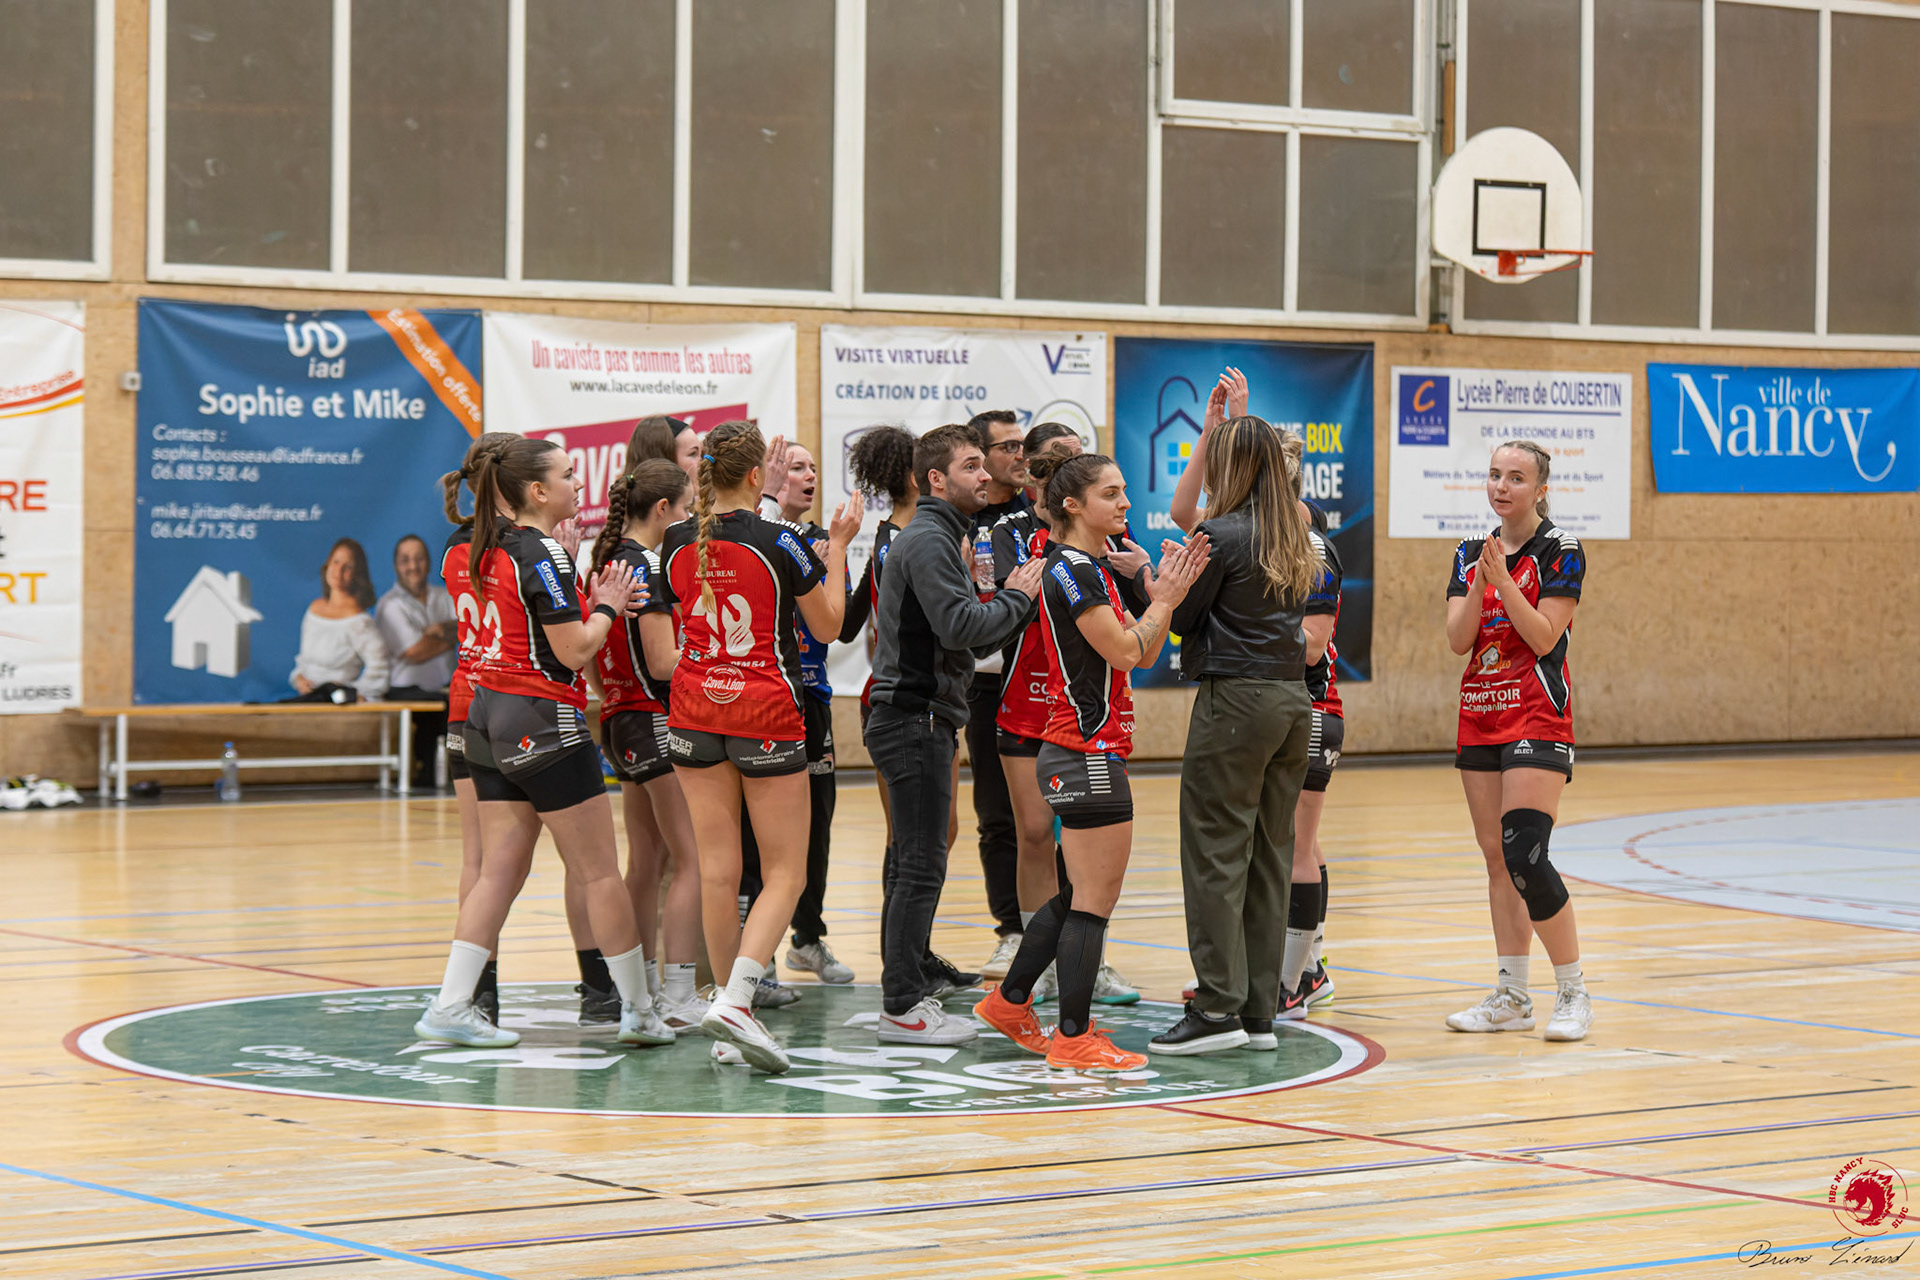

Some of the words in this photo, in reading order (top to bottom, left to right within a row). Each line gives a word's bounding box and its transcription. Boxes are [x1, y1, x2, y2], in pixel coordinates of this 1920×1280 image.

[308, 358, 345, 379] iad
[387, 308, 446, 377] Estimation
[442, 376, 482, 424] offerte
[532, 340, 550, 369] Un
[554, 342, 601, 371] caviste
[606, 350, 628, 375] pas
[632, 350, 681, 373] comme
[684, 345, 705, 374] les
[709, 347, 752, 375] autres
[835, 347, 884, 364] VISITE
[887, 349, 969, 365] VIRTUELLE
[570, 379, 718, 395] www.lacavedeleon.fr
[835, 380, 915, 401] CRÉATION
[920, 385, 939, 400] DE
[945, 385, 987, 401] LOGO
[1457, 377, 1492, 410] Lycée
[1495, 379, 1529, 405] Pierre
[1533, 381, 1547, 405] de
[1550, 382, 1622, 407] COUBERTIN
[1759, 375, 1802, 405] ville
[1807, 376, 1831, 405] de
[198, 384, 304, 424] Sophie
[312, 392, 346, 419] et
[353, 389, 426, 419] Mike
[152, 424, 217, 442] Contacts
[1306, 423, 1343, 453] BOX
[1512, 427, 1557, 439] SECONDE
[1577, 429, 1595, 440] BTS
[1671, 372, 1897, 483] Nancy
[1460, 688, 1520, 704] COMPTOIR
[1469, 702, 1507, 714] Campanile
[239, 1044, 480, 1085] Carrefour
[908, 1079, 1231, 1109] Carrefour
